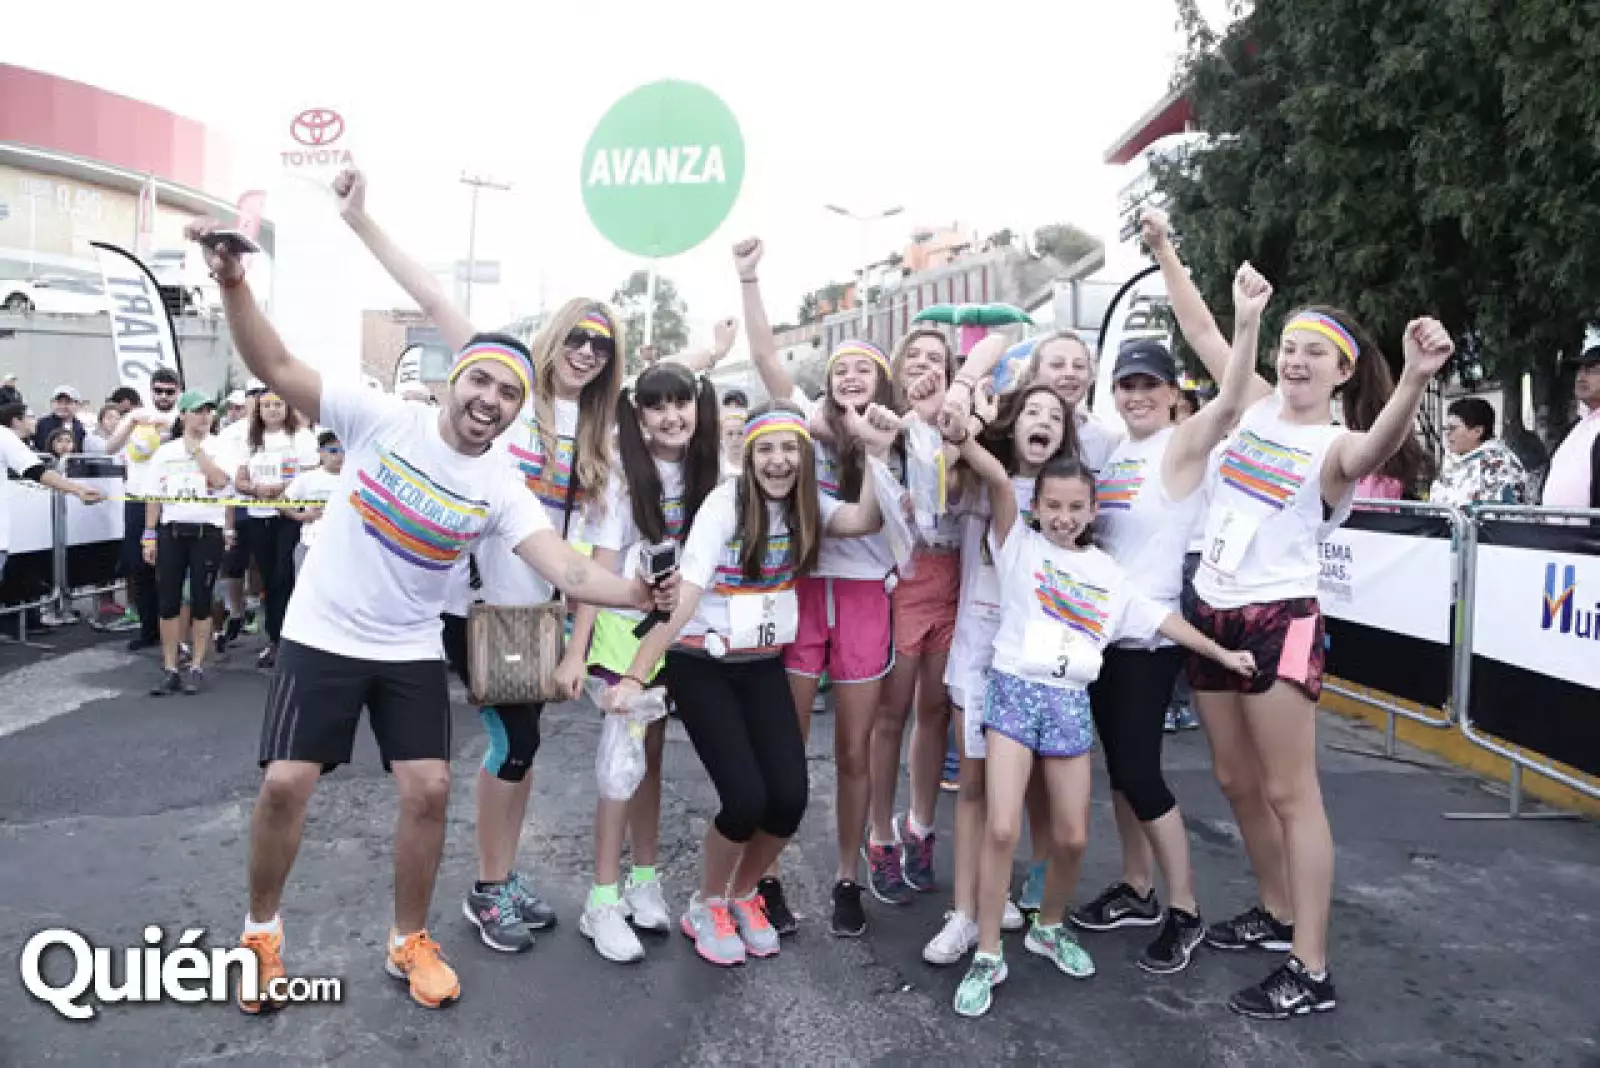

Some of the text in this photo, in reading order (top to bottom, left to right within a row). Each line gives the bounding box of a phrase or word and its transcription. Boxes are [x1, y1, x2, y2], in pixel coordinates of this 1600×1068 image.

[280, 149, 353, 167] TOYOTA
[586, 143, 726, 186] AVANZA
[757, 622, 776, 648] 16
[1051, 654, 1069, 679] 3
